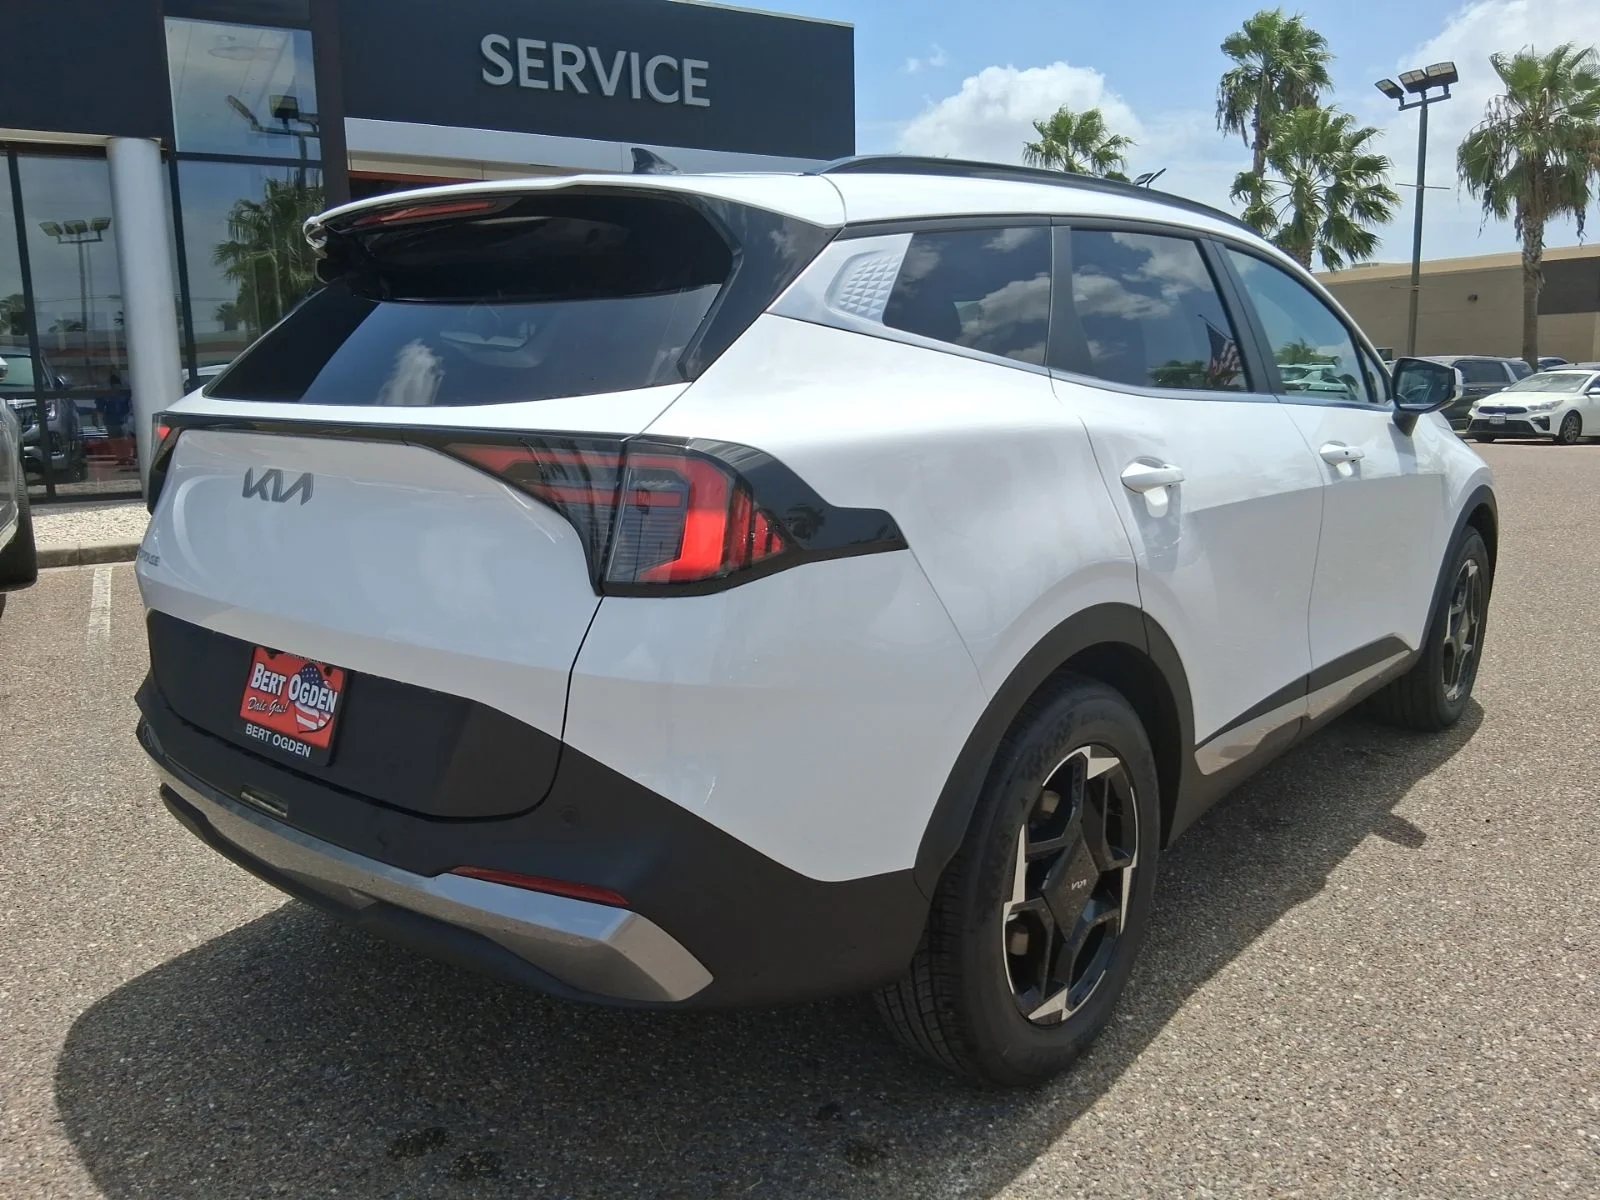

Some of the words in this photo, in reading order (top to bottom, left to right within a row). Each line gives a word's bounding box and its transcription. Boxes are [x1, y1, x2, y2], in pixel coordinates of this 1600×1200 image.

[480, 33, 711, 107] SERVICE
[241, 466, 314, 506] KIA
[245, 723, 272, 742] BERT
[272, 734, 312, 758] OGDEN
